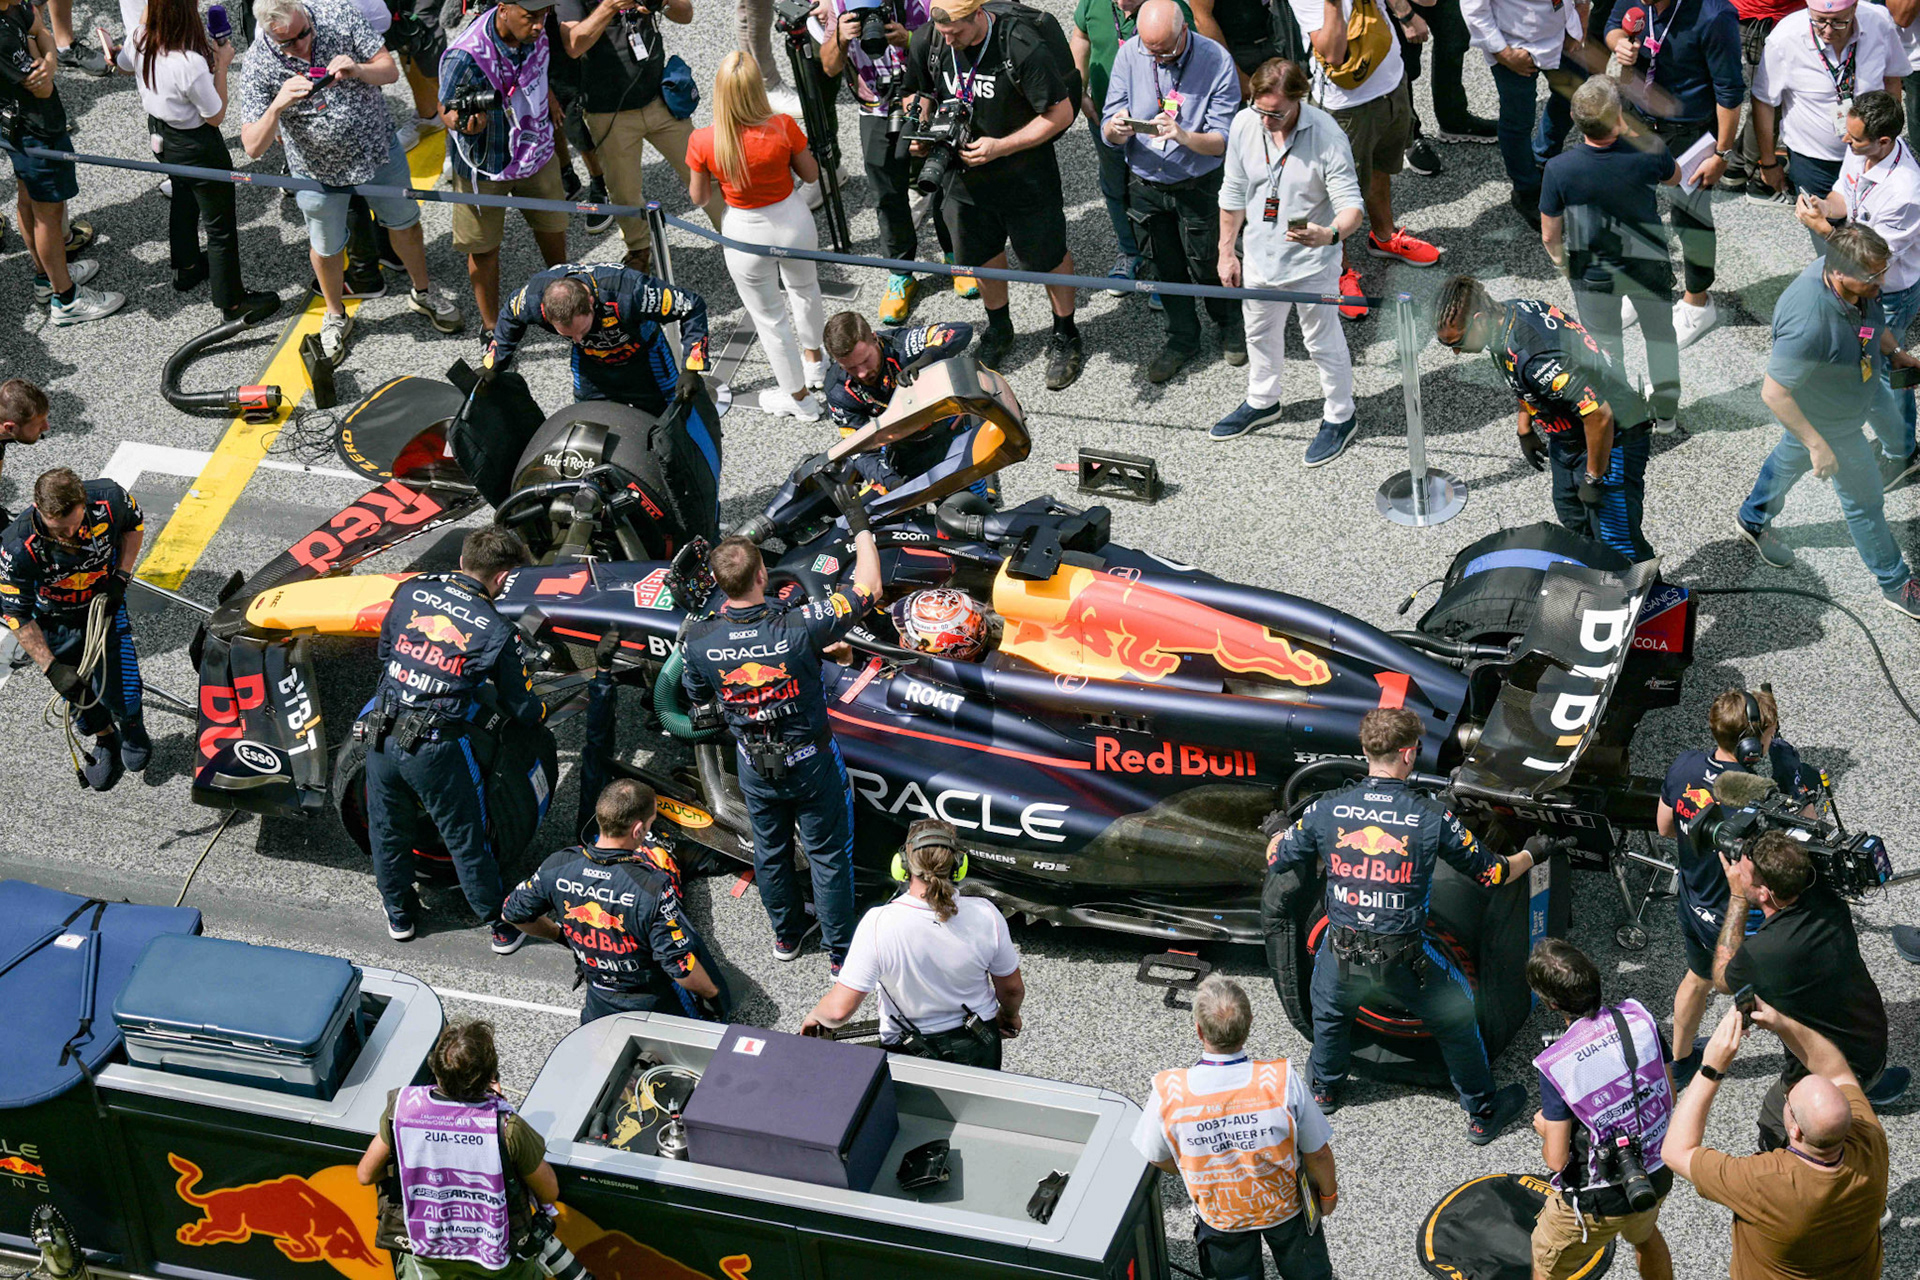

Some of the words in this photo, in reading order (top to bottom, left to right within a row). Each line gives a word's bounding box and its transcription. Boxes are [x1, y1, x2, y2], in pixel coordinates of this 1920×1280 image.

[543, 453, 568, 467] Hard
[570, 457, 596, 470] Rock
[892, 531, 930, 541] zoom
[412, 589, 491, 631] ORACLE
[706, 639, 790, 662] ORACLE
[1634, 637, 1678, 651] COLA
[424, 645, 468, 677] Bull
[388, 660, 432, 692] Mobil
[905, 681, 966, 713] ROKT
[1095, 736, 1173, 775] Red
[1179, 744, 1258, 777] Bull
[846, 767, 1071, 843] RACLE
[1332, 804, 1421, 827] ORACLE
[1460, 797, 1558, 823] Mobil
[969, 849, 1017, 865] SIEMENS
[1330, 853, 1369, 879] Red
[1370, 859, 1414, 884] Bull
[555, 877, 636, 908] ORACLE
[1333, 884, 1383, 909] Mobil
[563, 923, 597, 949] Red
[599, 932, 639, 955] Bull
[574, 946, 619, 972] Mobil
[1196, 1113, 1258, 1132] 0037-AUS
[1187, 1128, 1258, 1146] SCRUTINEER
[1260, 1126, 1274, 1137] F1
[1211, 1140, 1256, 1154] GARAGE
[598, 1178, 640, 1191] VERSTAPPEN
[1196, 1170, 1293, 1201] PITLANE
[1206, 1201, 1240, 1213] ALL
